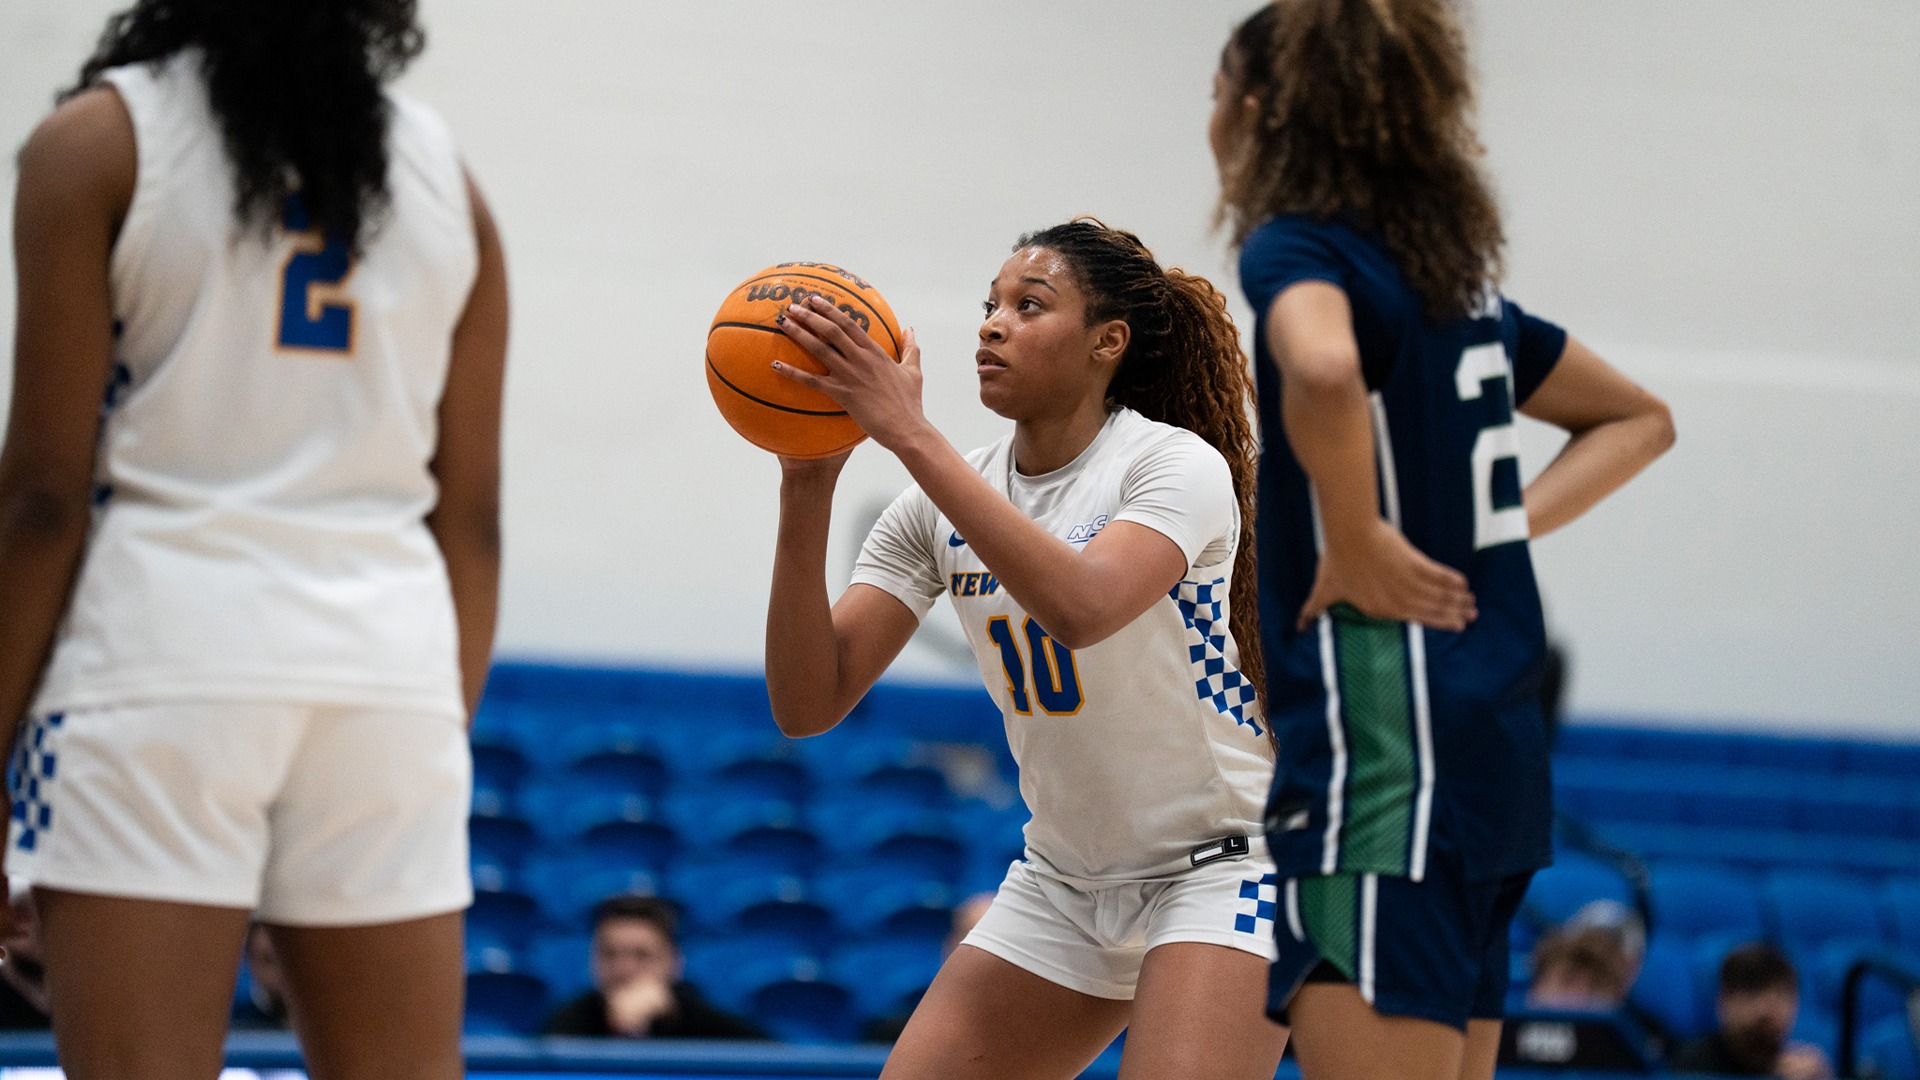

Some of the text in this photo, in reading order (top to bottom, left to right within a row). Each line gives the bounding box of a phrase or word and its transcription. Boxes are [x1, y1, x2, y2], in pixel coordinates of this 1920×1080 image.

[273, 188, 359, 358] 2
[746, 283, 870, 334] Wson
[950, 571, 1000, 597] NEW
[986, 615, 1085, 716] 10
[1230, 838, 1239, 847] L
